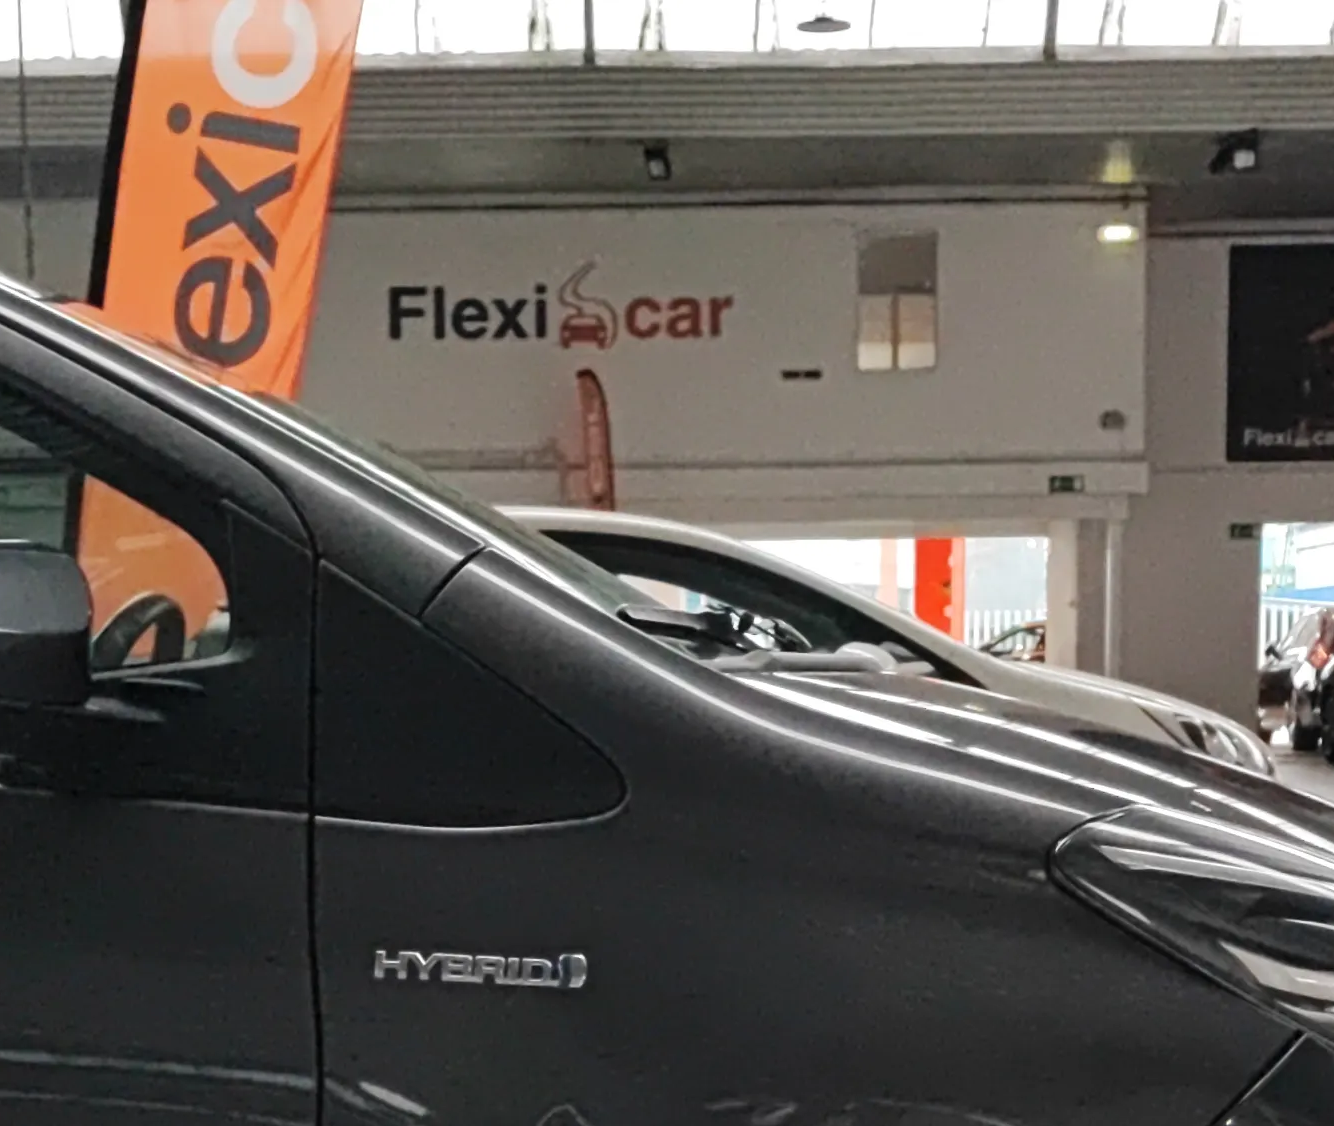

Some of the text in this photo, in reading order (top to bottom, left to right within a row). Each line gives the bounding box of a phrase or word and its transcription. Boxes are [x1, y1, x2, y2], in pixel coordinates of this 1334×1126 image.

[387, 283, 735, 341] Flexi car
[1243, 427, 1292, 447] Flexi
[373, 949, 560, 987] HYBRID
